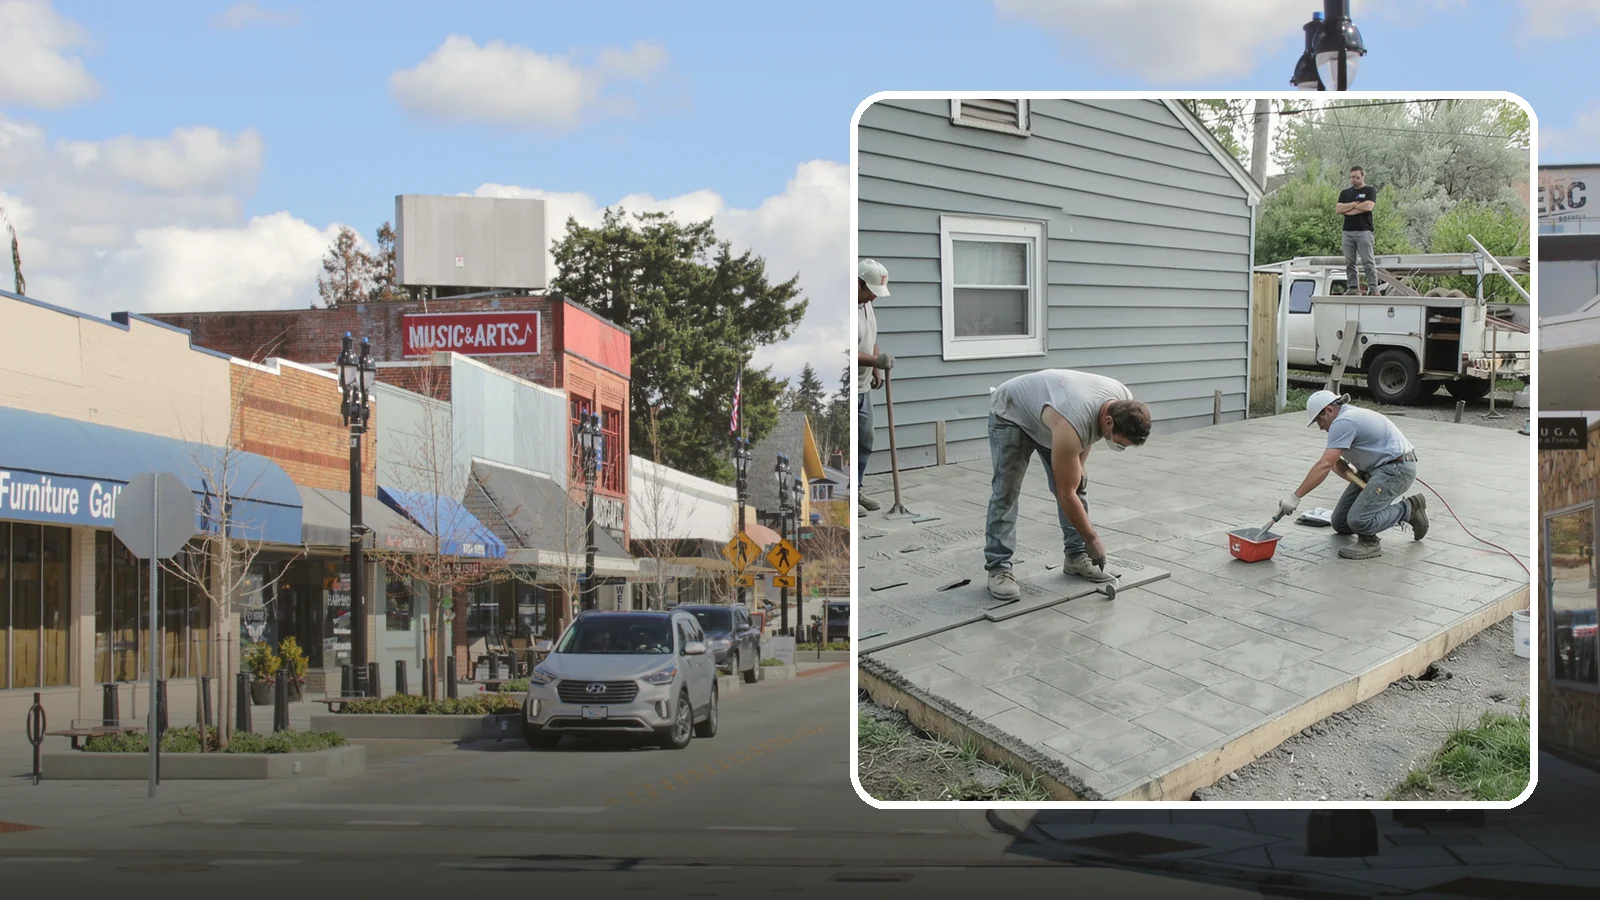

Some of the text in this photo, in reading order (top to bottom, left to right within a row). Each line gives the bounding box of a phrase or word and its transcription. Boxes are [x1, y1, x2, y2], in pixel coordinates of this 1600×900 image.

[0, 471, 122, 519] Furniture Gal
[453, 563, 479, 575] SUSHI
